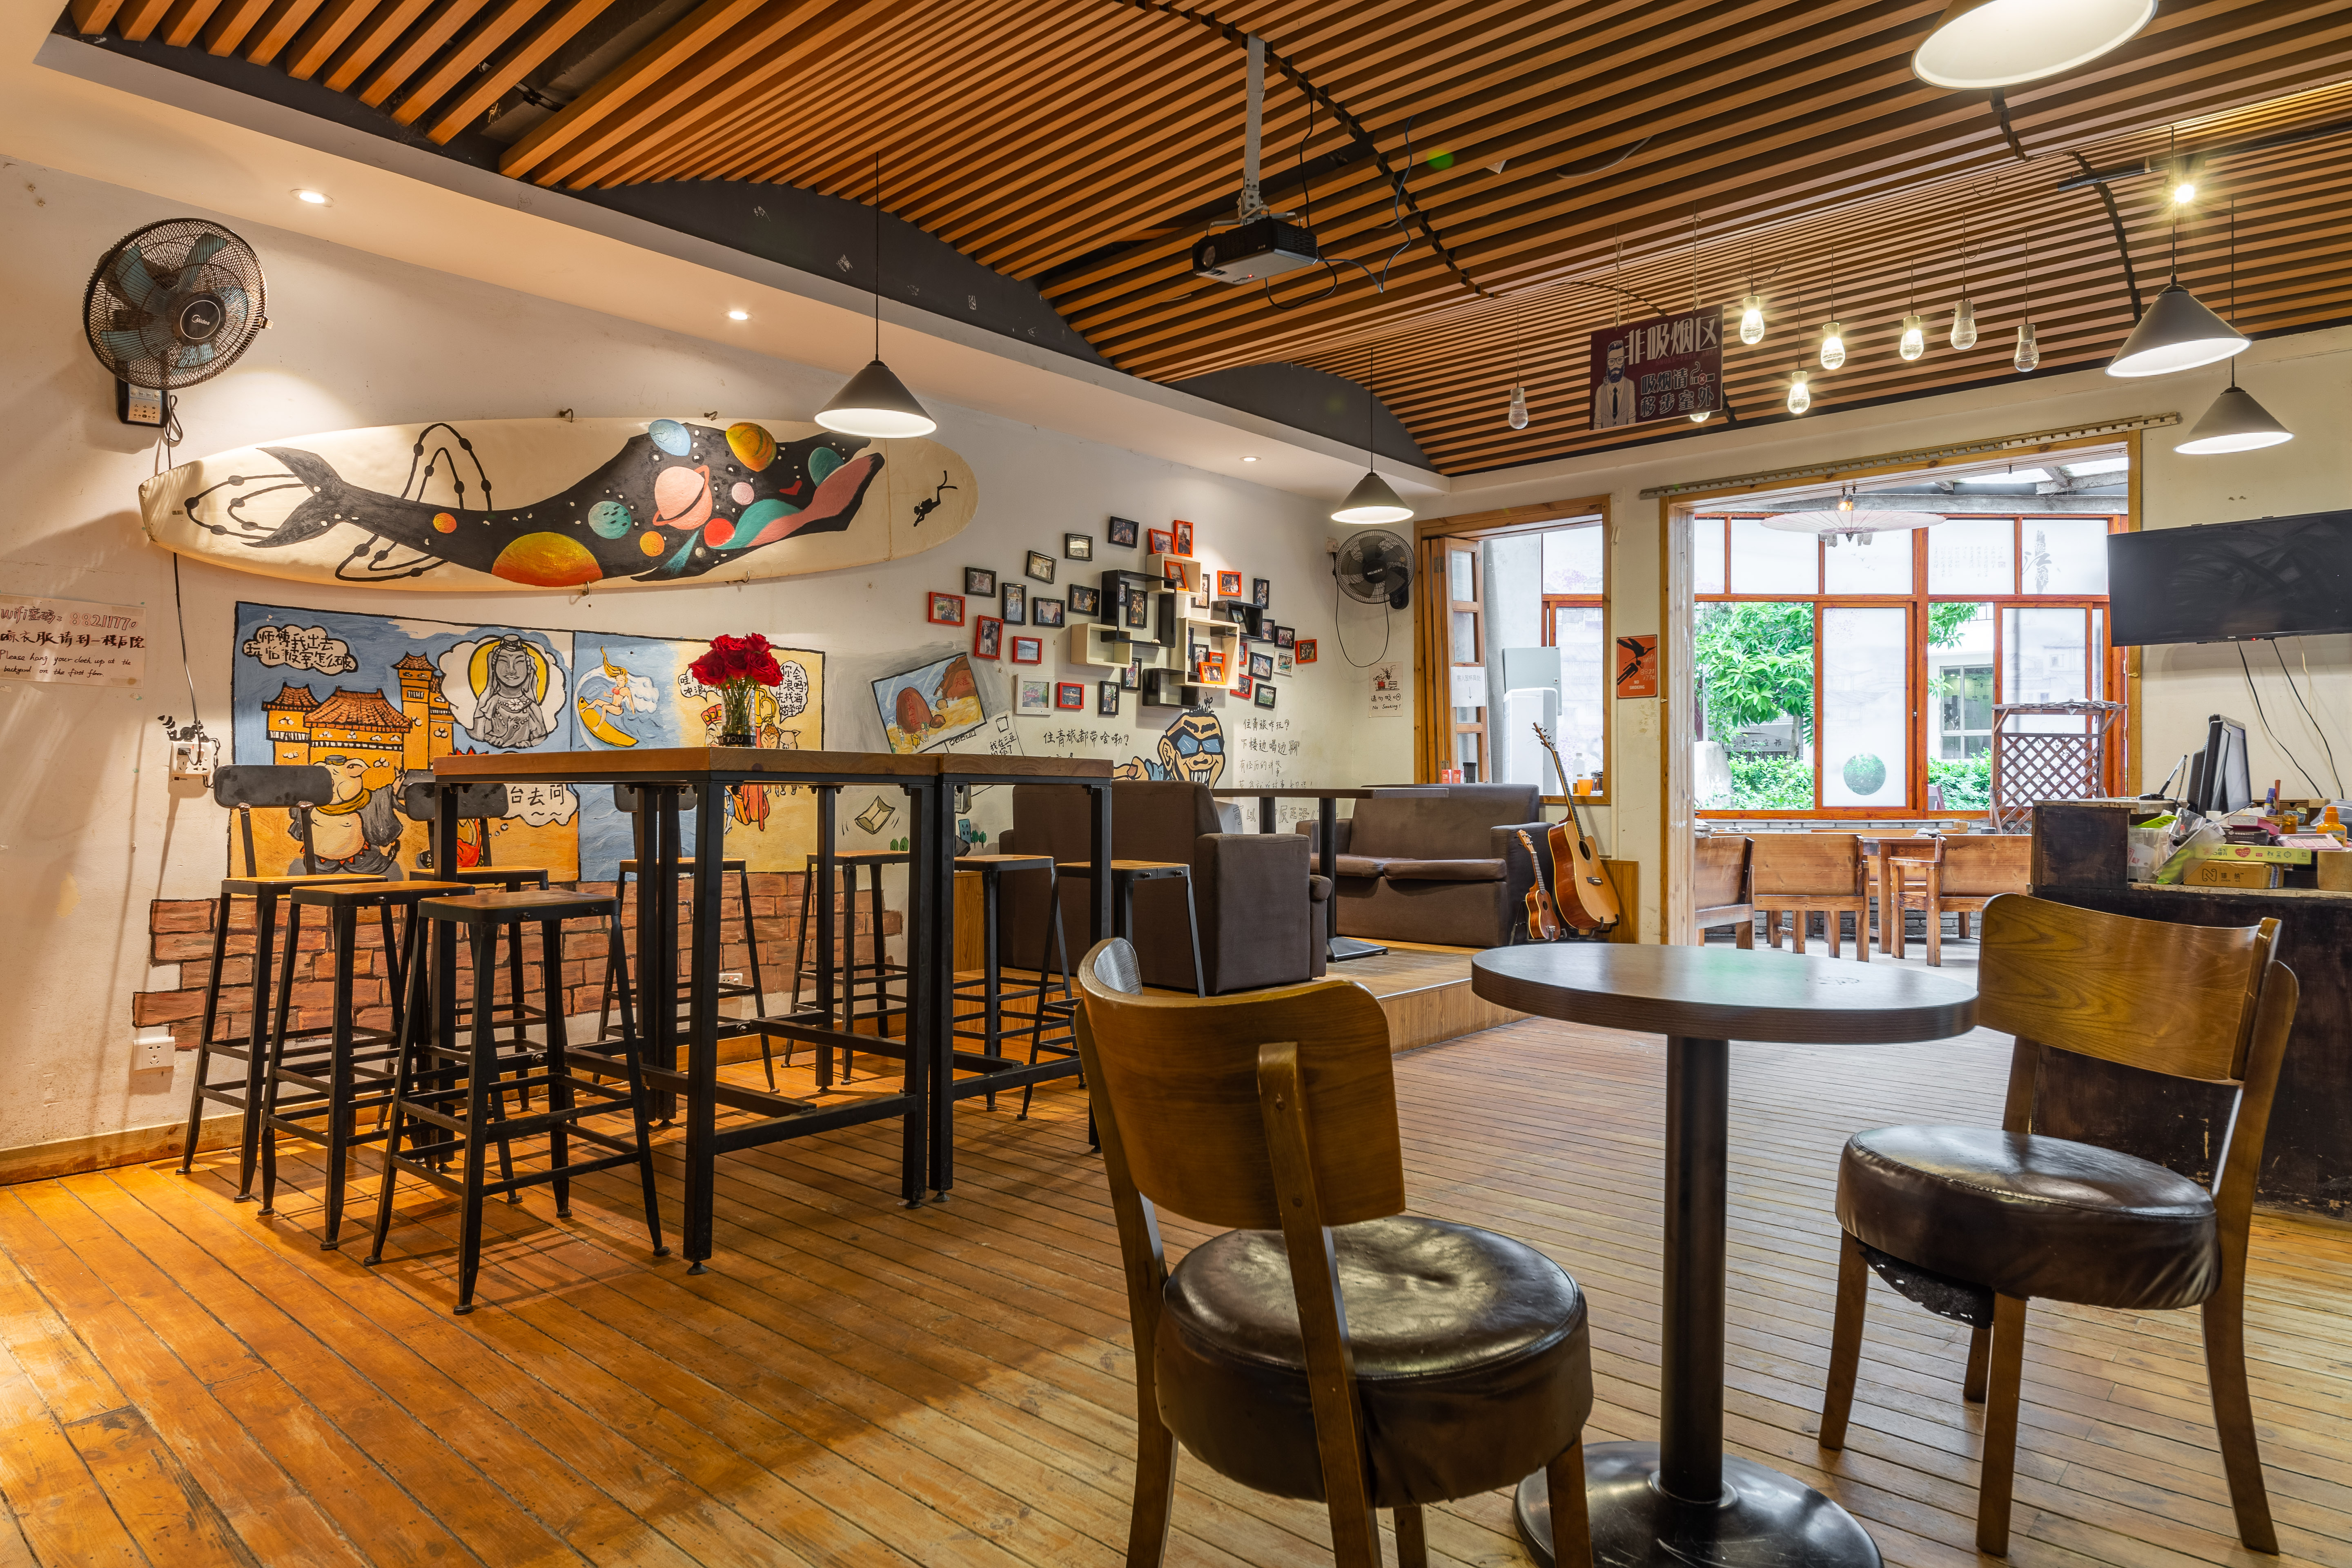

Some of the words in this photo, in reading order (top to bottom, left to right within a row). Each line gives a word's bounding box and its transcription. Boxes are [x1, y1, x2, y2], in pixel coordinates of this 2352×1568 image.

[192, 314, 210, 325] Midea
[1625, 314, 1718, 365] 非吸烟区
[1655, 352, 1697, 366] SMOKE-FREE
[1641, 368, 1688, 395] 吸烟请
[1640, 385, 1714, 417] 移步室外
[69, 611, 138, 630] 88211770
[0, 630, 145, 648] 晾衣服请到一楼后院
[0, 649, 25, 660] Please
[30, 653, 48, 665] hang
[53, 656, 73, 666] your
[74, 656, 92, 664] cloth
[4, 666, 32, 675] backyard
[68, 670, 84, 678] first
[781, 665, 802, 679] 你会
[776, 691, 803, 705] 先找海
[904, 691, 920, 727] 南天一柱
[989, 732, 1017, 751] 我在三亚
[1241, 737, 1300, 757] 下楼边喝边聊
[510, 784, 565, 806] 台去问
